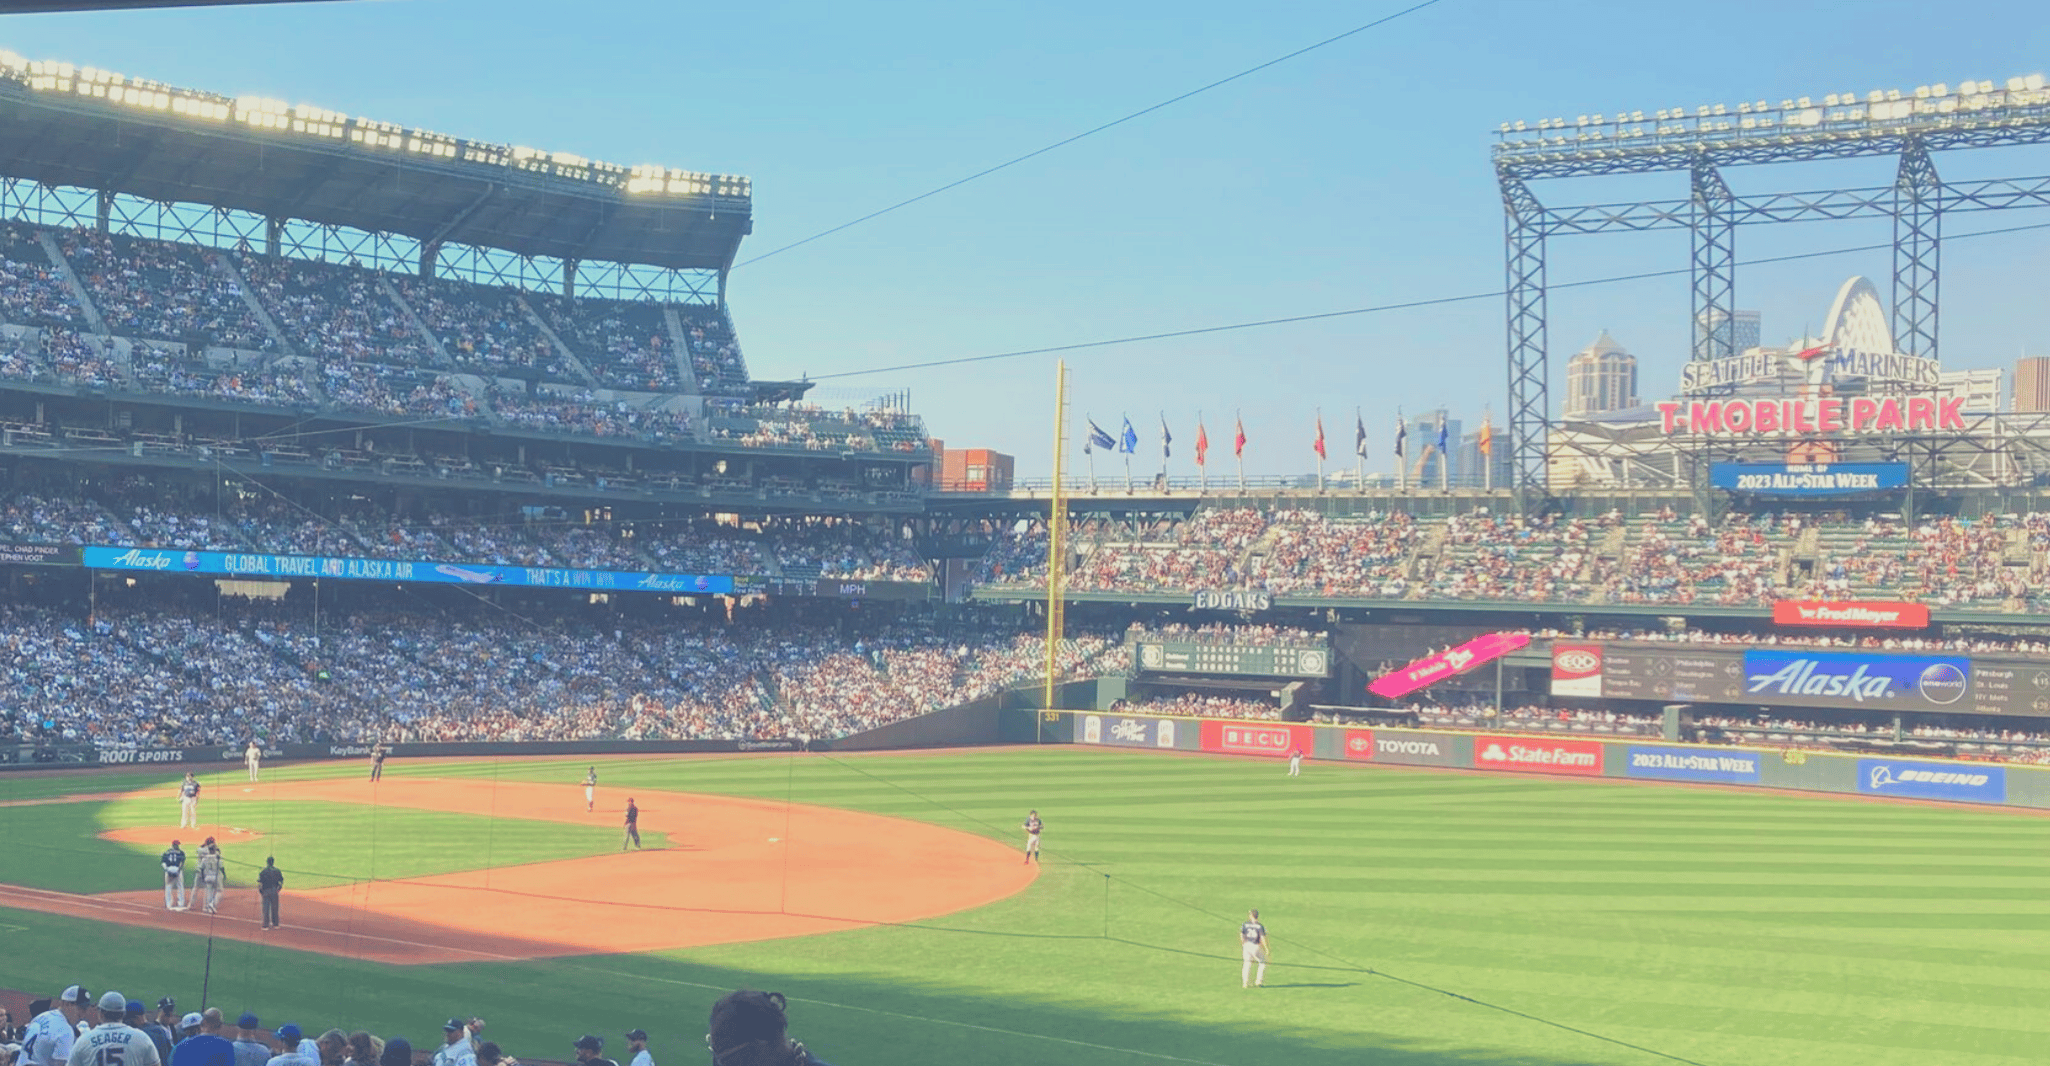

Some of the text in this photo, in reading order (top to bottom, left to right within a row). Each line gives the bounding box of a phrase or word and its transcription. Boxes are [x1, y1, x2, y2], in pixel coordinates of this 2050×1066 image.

[1682, 348, 1940, 388] SEATTLE MARINERS
[1658, 396, 1966, 433] T-MOBILE PARK
[1737, 474, 1770, 488] 2023
[1837, 473, 1878, 488] WEEK
[112, 549, 171, 570] Alaska
[225, 554, 413, 578] GLOBAL TRAVEL AND ALASKA AIR
[526, 568, 560, 585] THAT'S
[563, 570, 569, 585] A
[637, 574, 685, 591] Alaska
[840, 584, 865, 595] MPH
[1748, 659, 1892, 702] Alaska
[1976, 669, 2014, 679] Pittsburgh
[1045, 713, 1060, 722] 331
[1227, 731, 1284, 745] BECU
[99, 749, 183, 763] ROOT SPORTS
[330, 745, 371, 756] KeyBank
[1377, 739, 1439, 756] TOYOTA
[1632, 753, 1662, 767] 2023
[1720, 758, 1755, 773] WEEK
[1898, 770, 1988, 786] BOEING
[24, 1034, 38, 1059] 4
[90, 1032, 132, 1047] SEAGER
[96, 1047, 124, 1066] 15
